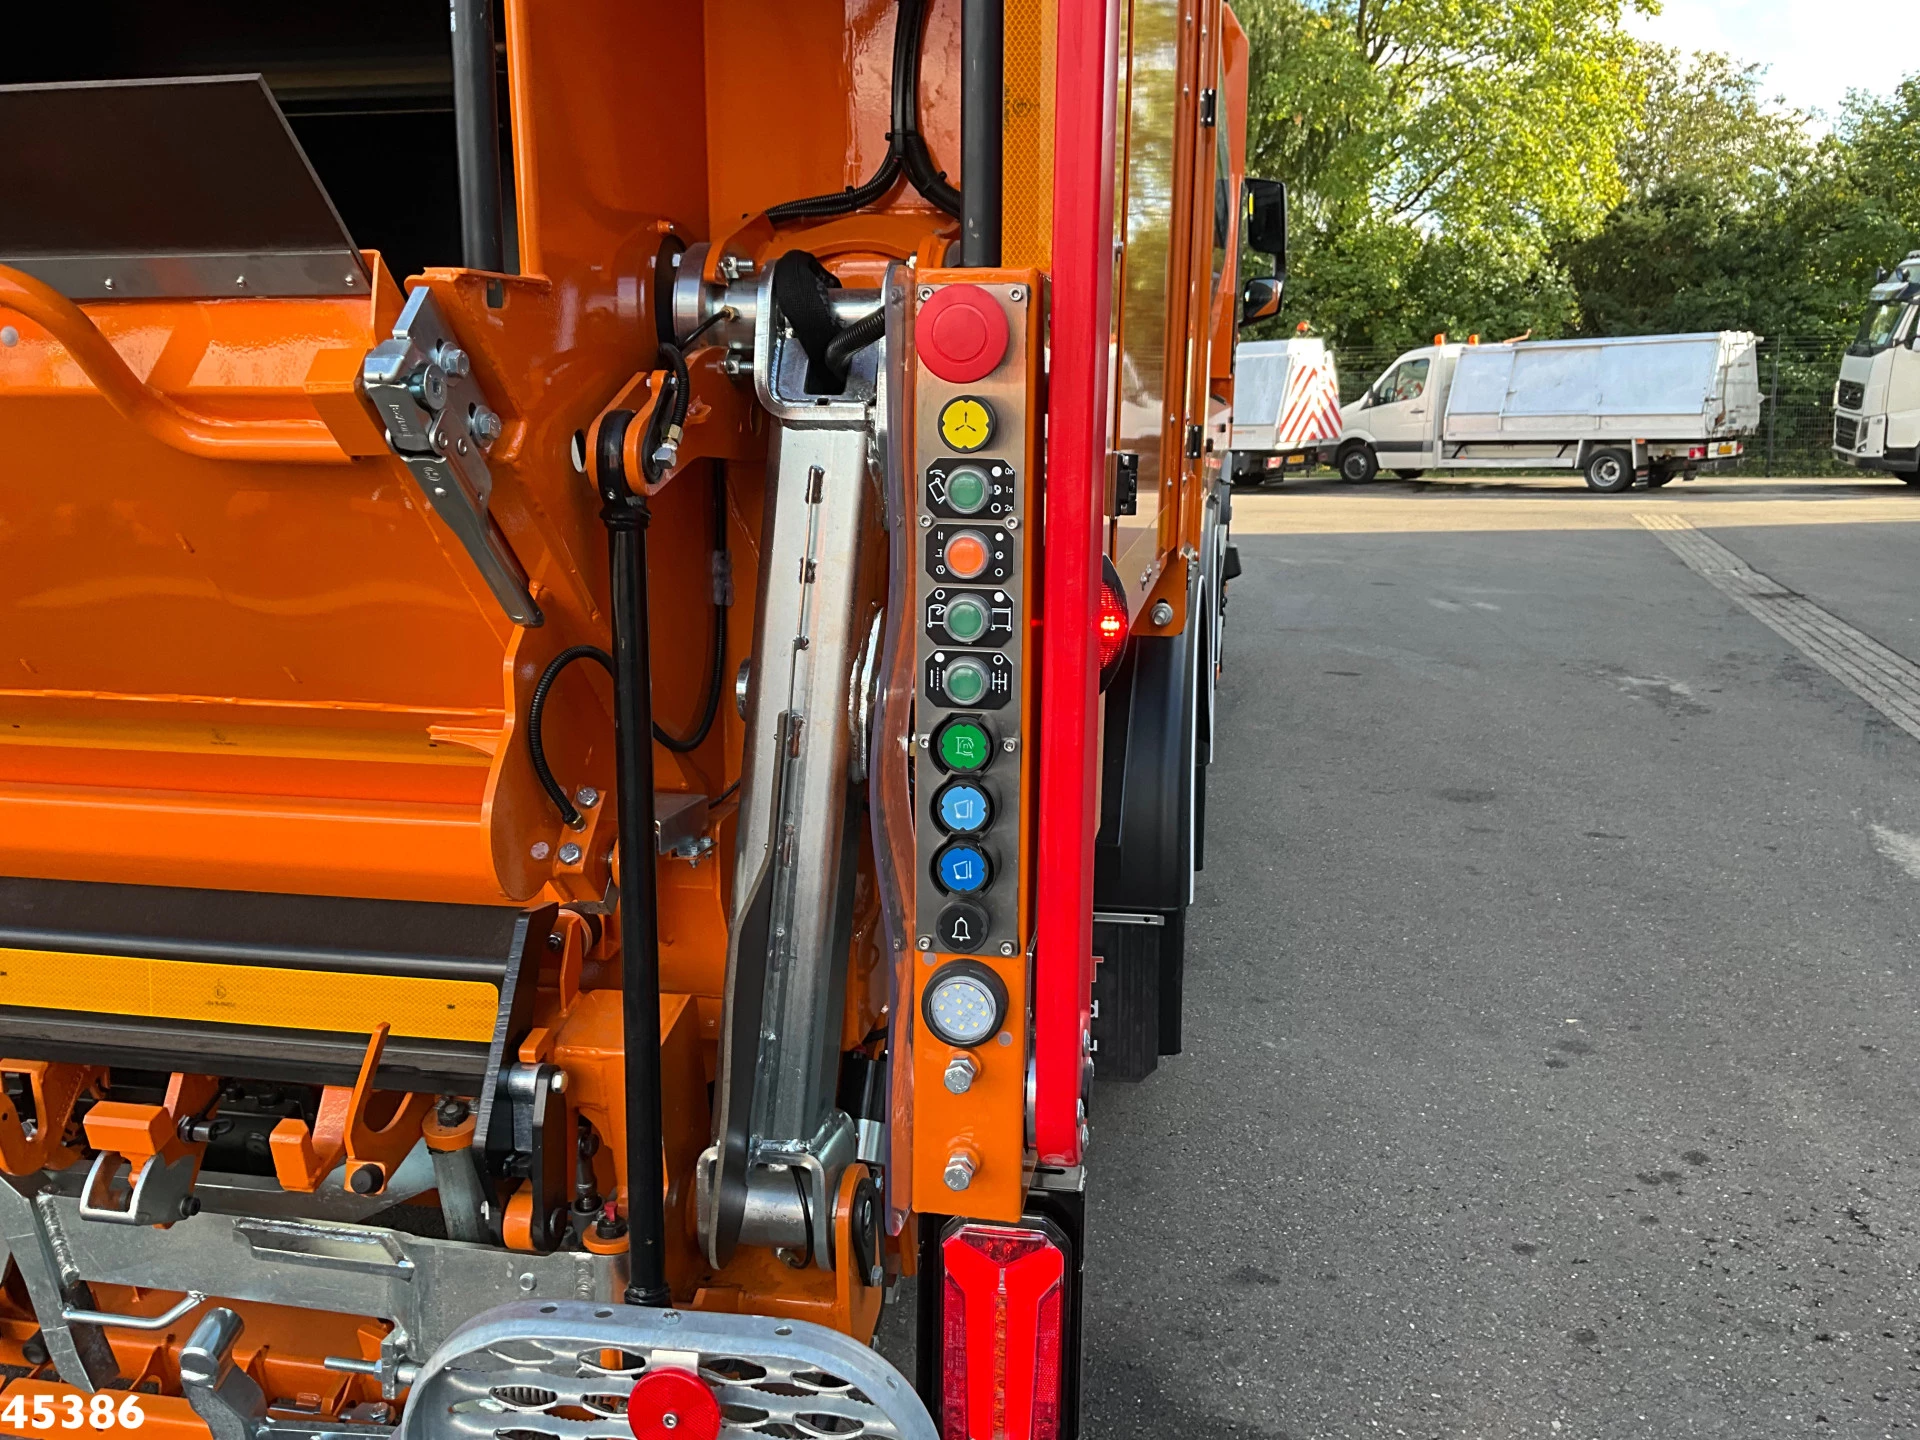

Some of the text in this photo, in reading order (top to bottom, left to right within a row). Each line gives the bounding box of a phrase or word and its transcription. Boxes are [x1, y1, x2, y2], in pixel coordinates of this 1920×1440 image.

[1004, 467, 1014, 475] 0x
[1005, 485, 1014, 494] 1x
[1004, 504, 1014, 513] 2x
